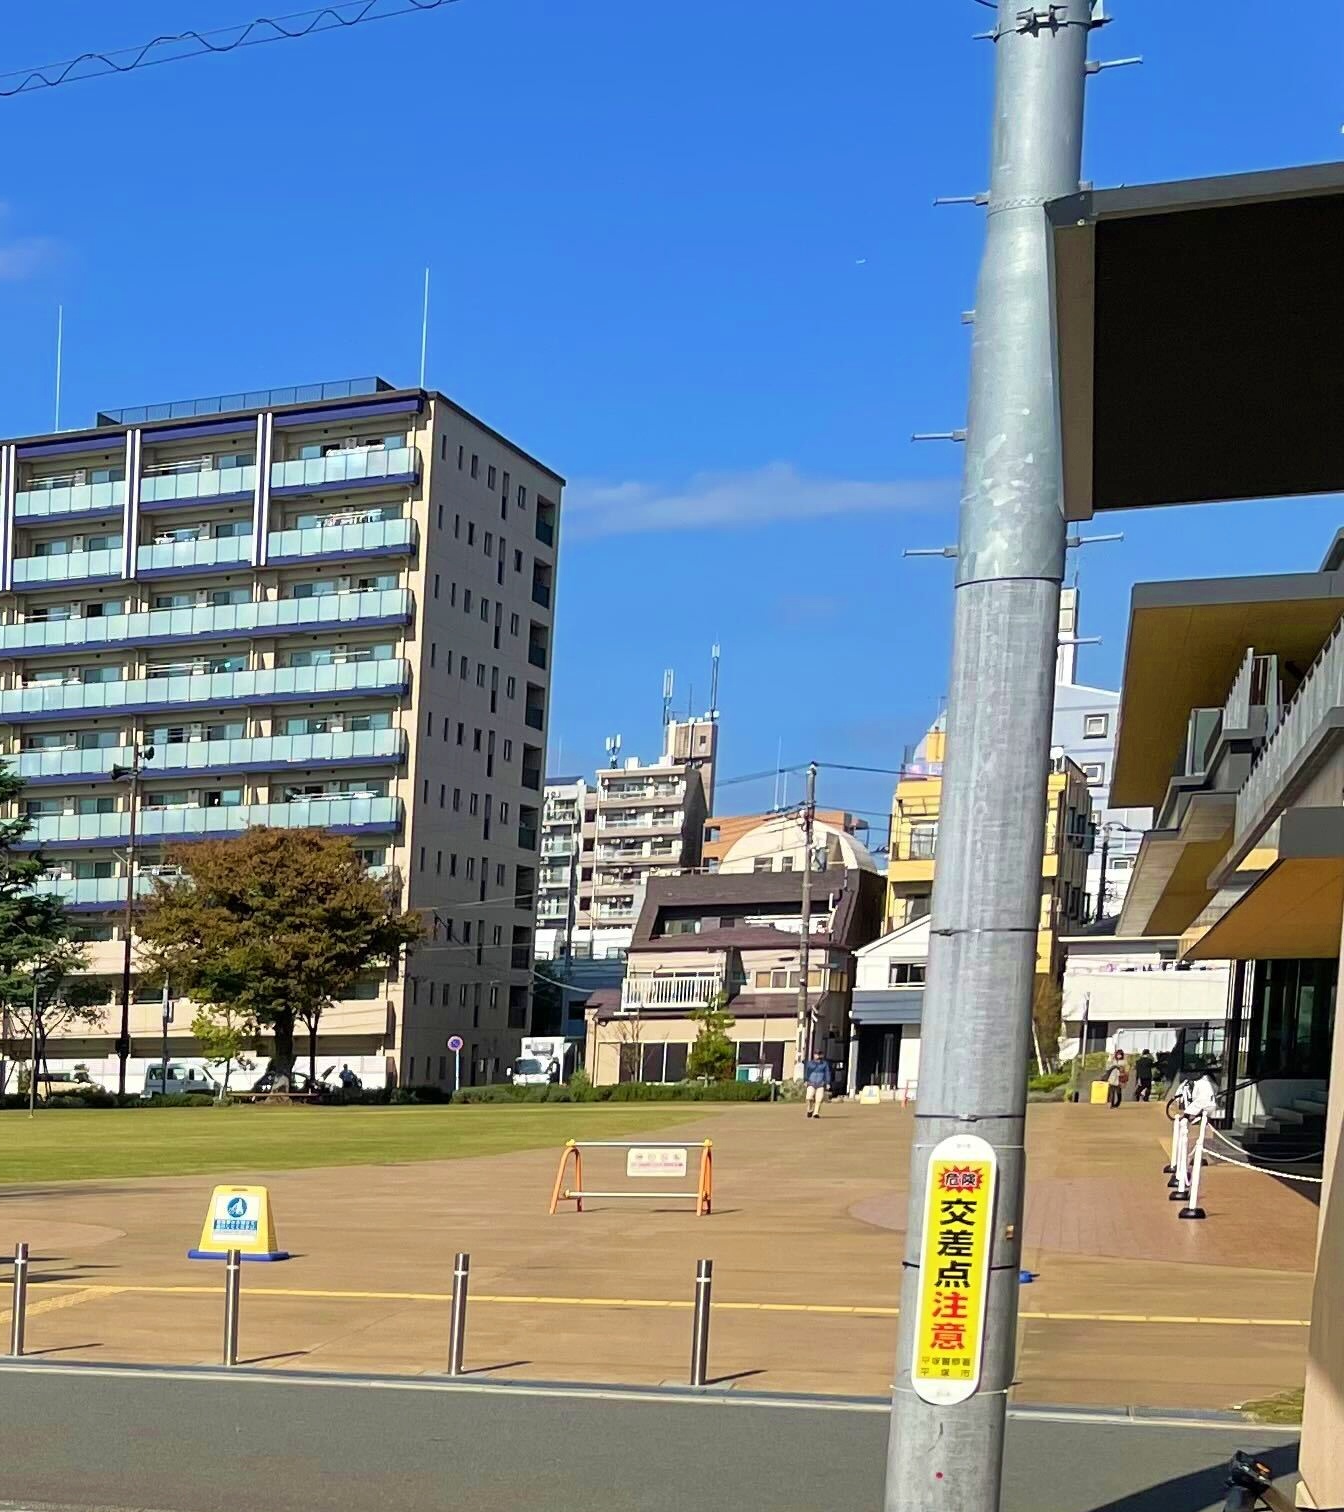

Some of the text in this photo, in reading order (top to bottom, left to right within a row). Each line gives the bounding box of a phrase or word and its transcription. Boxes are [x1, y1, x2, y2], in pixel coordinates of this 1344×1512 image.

[945, 1173, 976, 1186] 危険
[930, 1198, 978, 1350] 交差点注意
